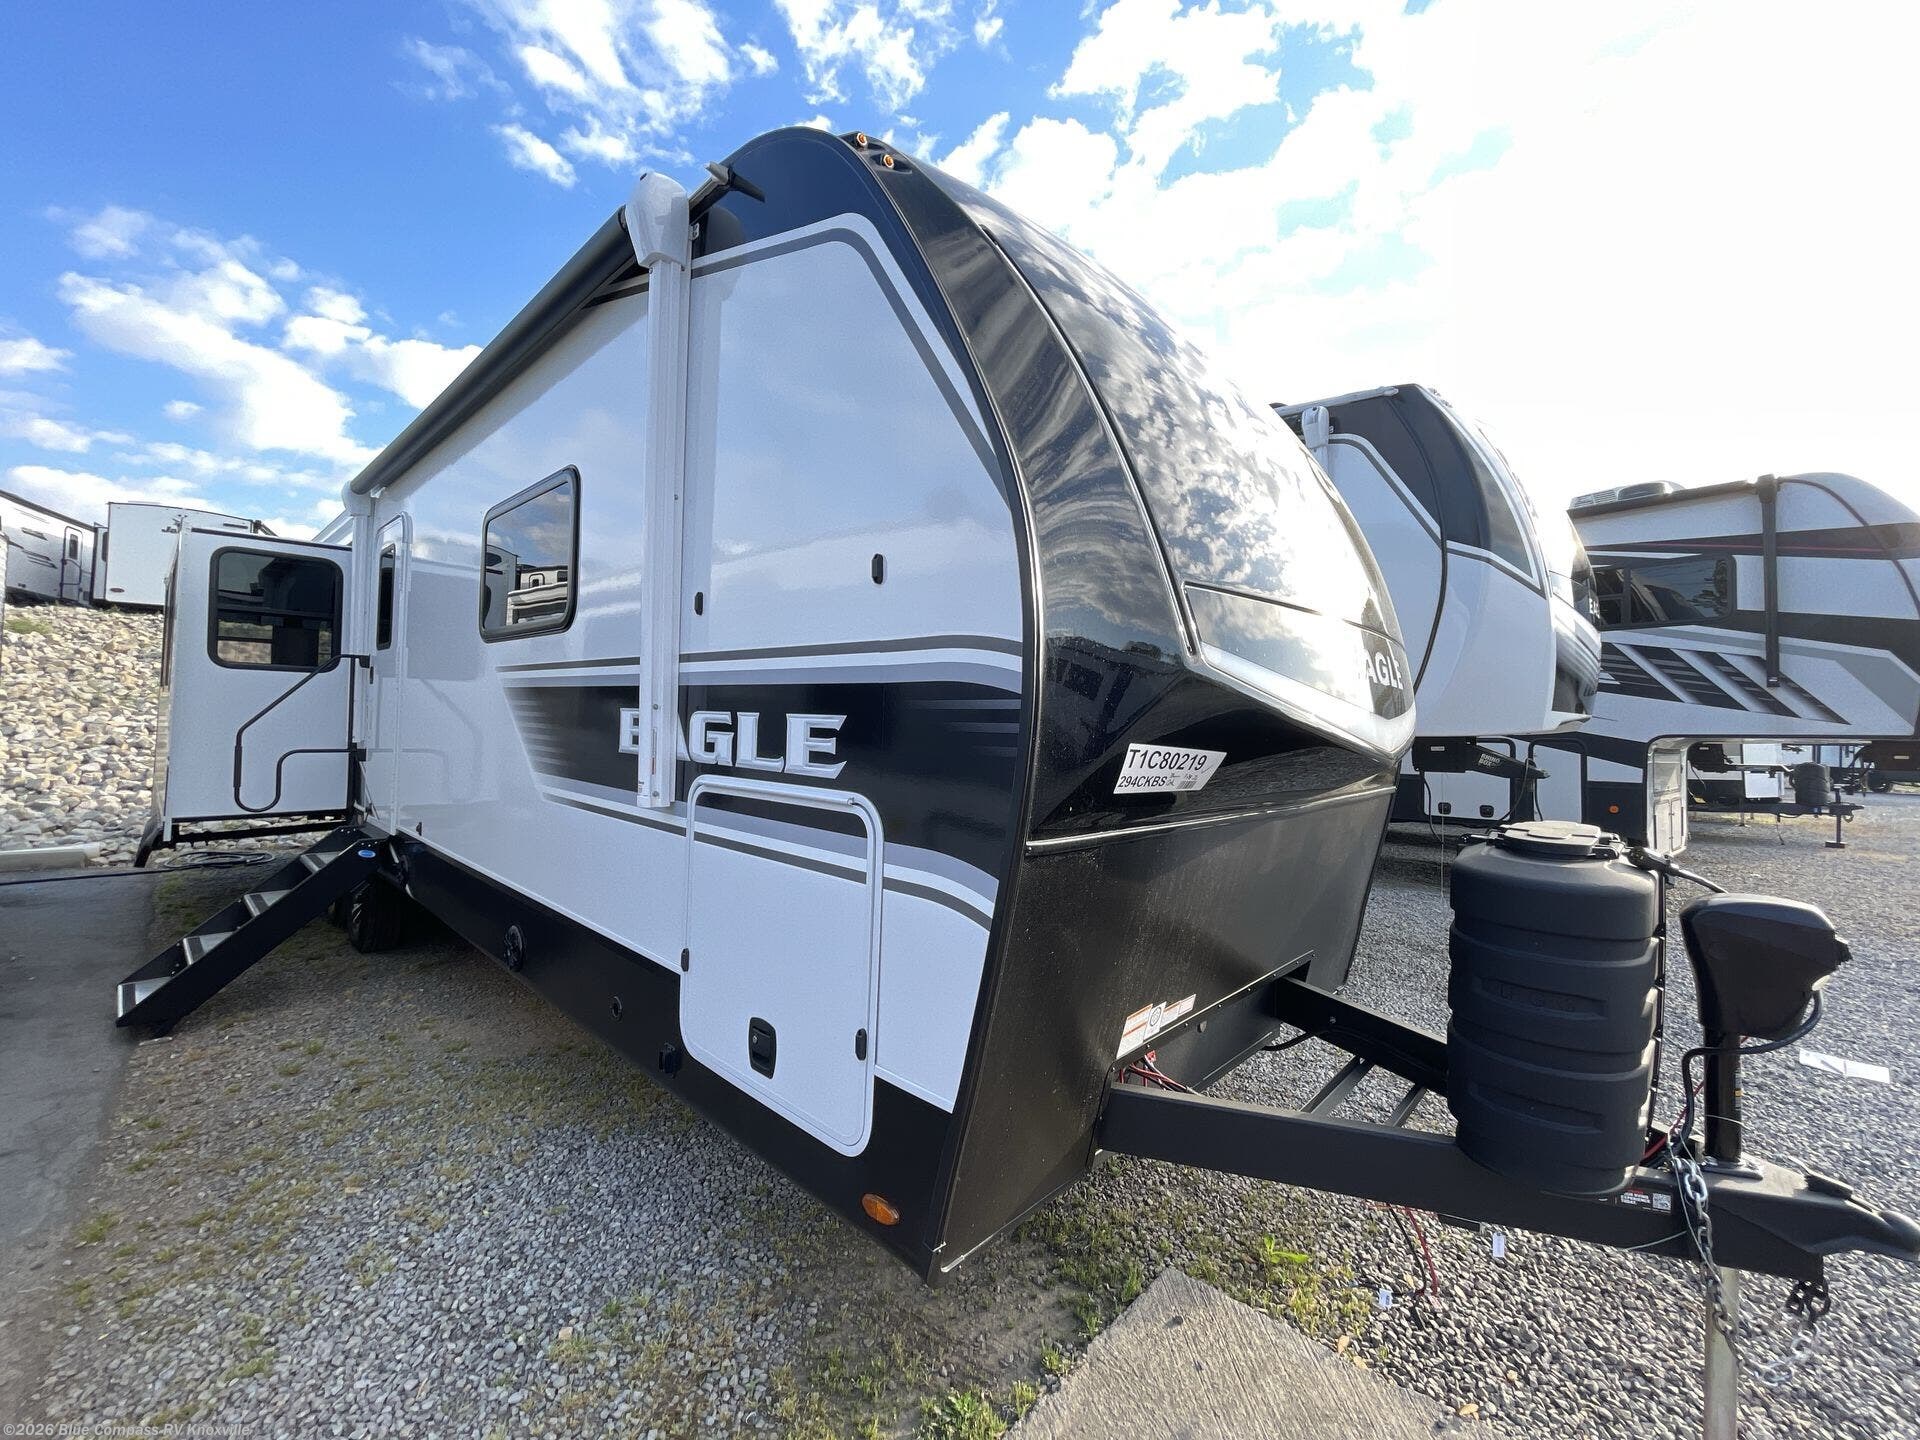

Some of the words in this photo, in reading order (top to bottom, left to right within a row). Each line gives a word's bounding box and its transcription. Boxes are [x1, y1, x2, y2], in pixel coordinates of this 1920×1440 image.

[1364, 648, 1403, 690] AGLE
[1128, 749, 1208, 771] T1C80219
[1117, 775, 1167, 787] 294CKBS
